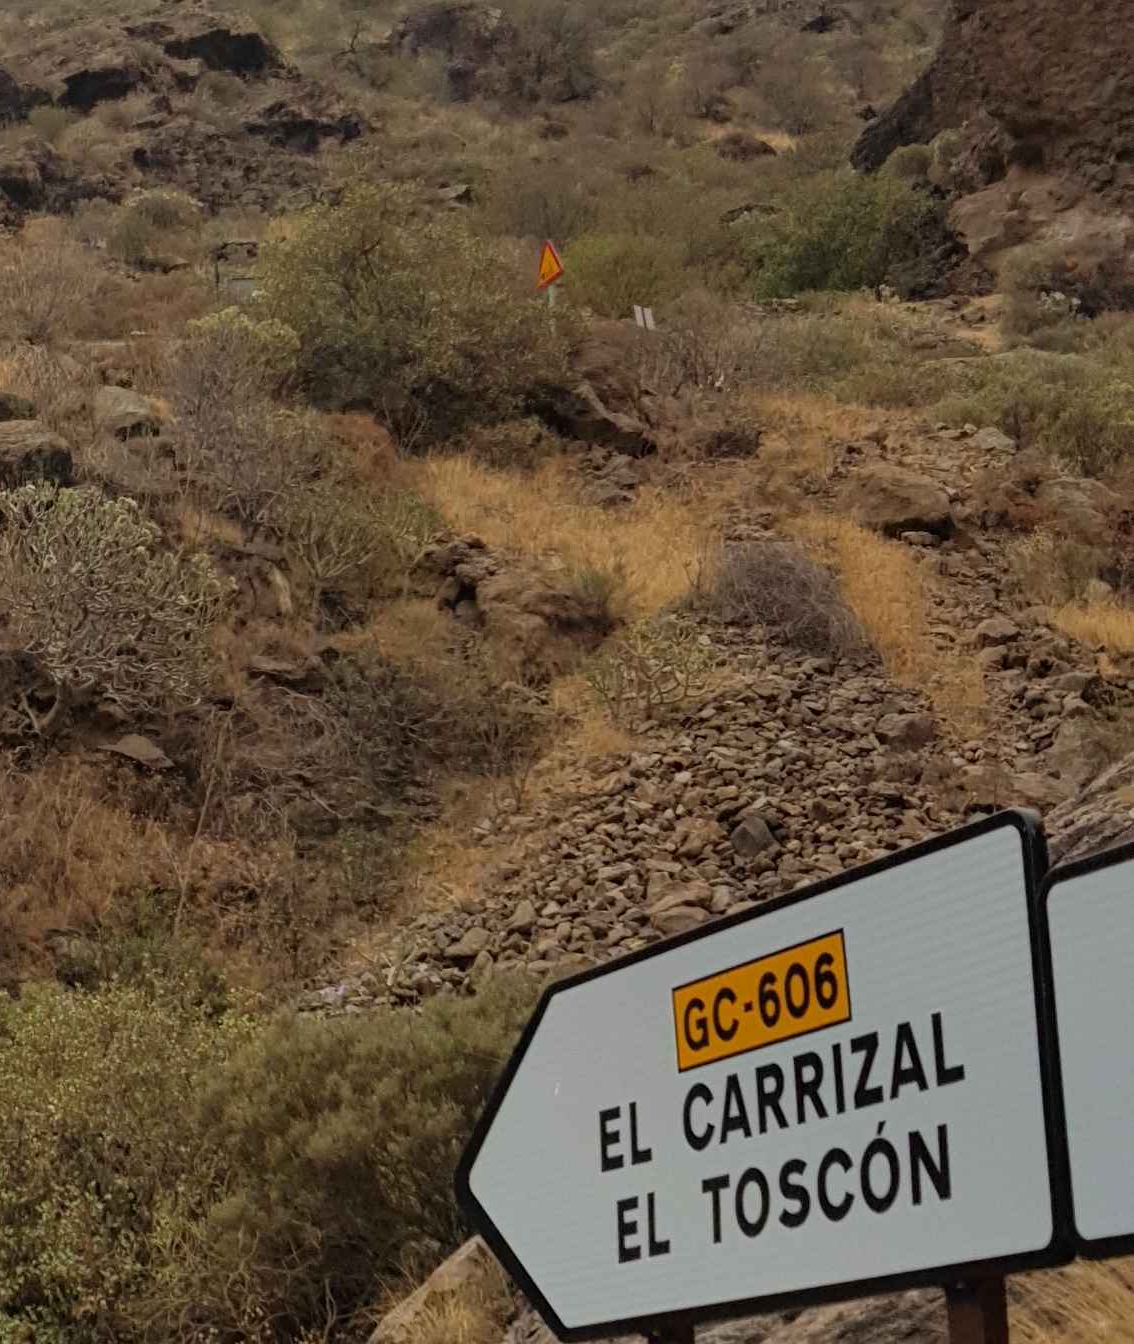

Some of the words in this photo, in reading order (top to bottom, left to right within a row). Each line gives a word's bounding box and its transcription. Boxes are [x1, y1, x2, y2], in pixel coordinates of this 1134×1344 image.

[683, 953, 840, 1052] GC-606
[599, 1102, 652, 1172] EL
[682, 1012, 965, 1152] CARRIZAL
[617, 1192, 671, 1263] EL
[702, 1121, 952, 1245] TOSCÓN
